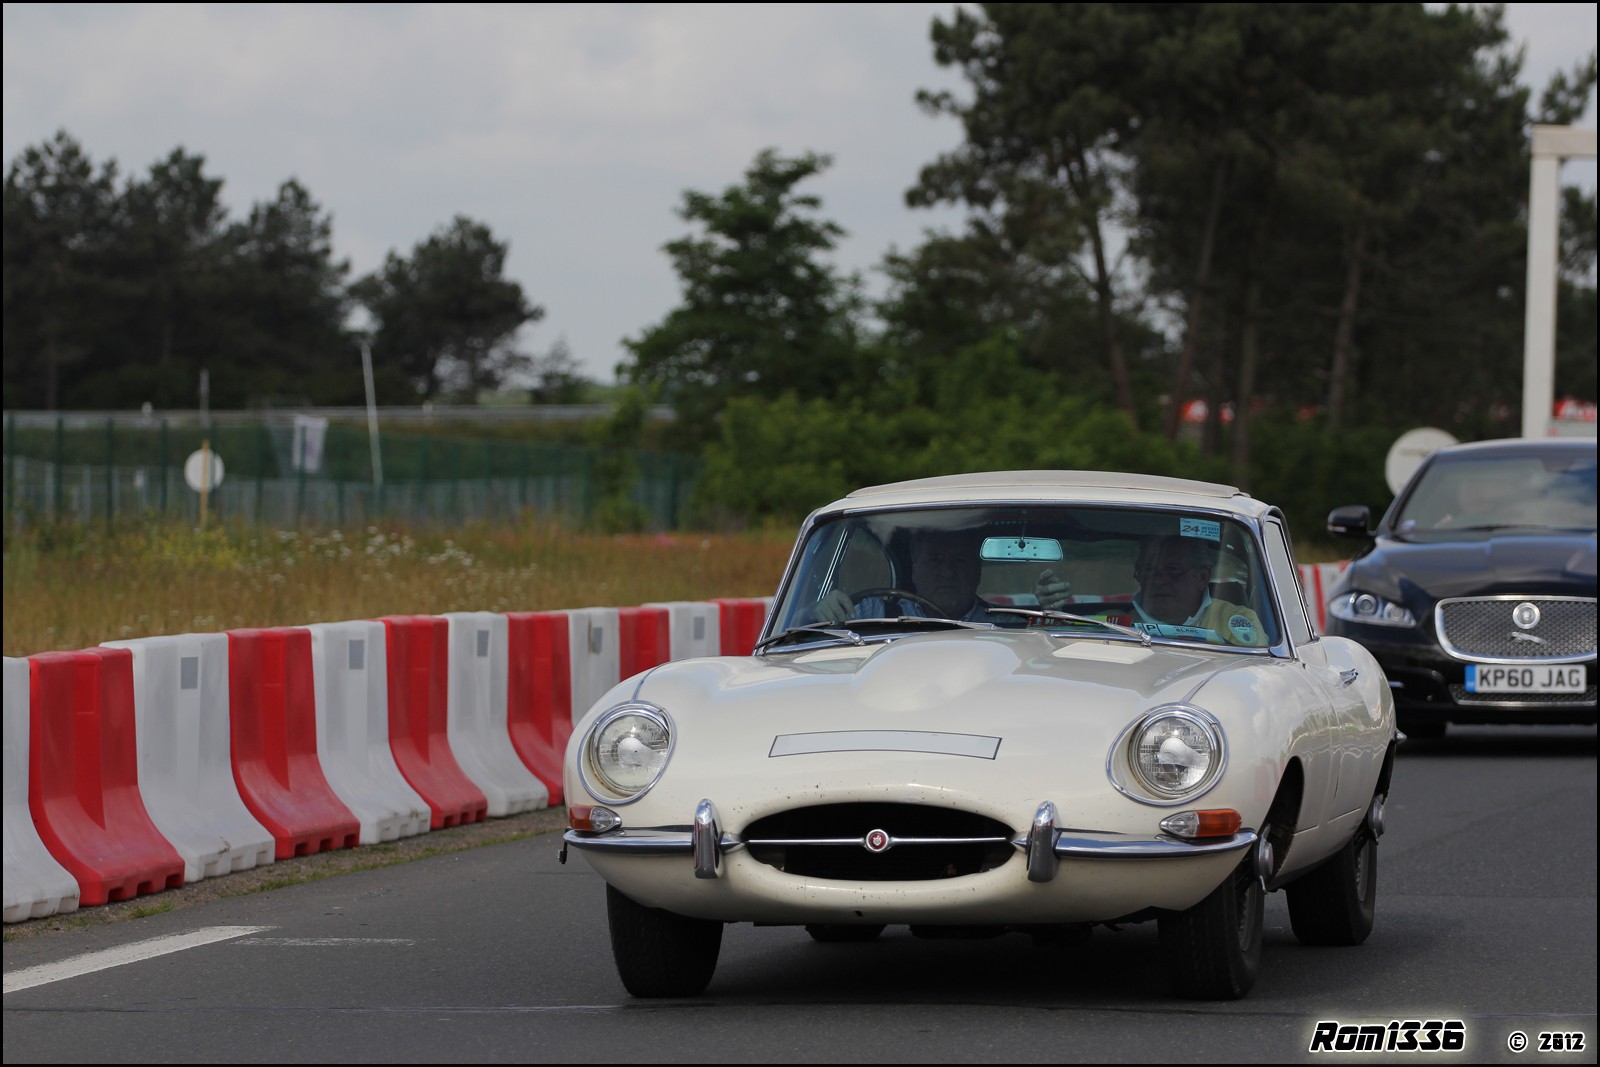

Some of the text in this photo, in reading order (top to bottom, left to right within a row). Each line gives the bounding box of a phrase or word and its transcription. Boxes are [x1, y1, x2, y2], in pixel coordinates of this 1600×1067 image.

[1182, 525, 1200, 533] 24
[1479, 668, 1581, 688] KP60 JAG
